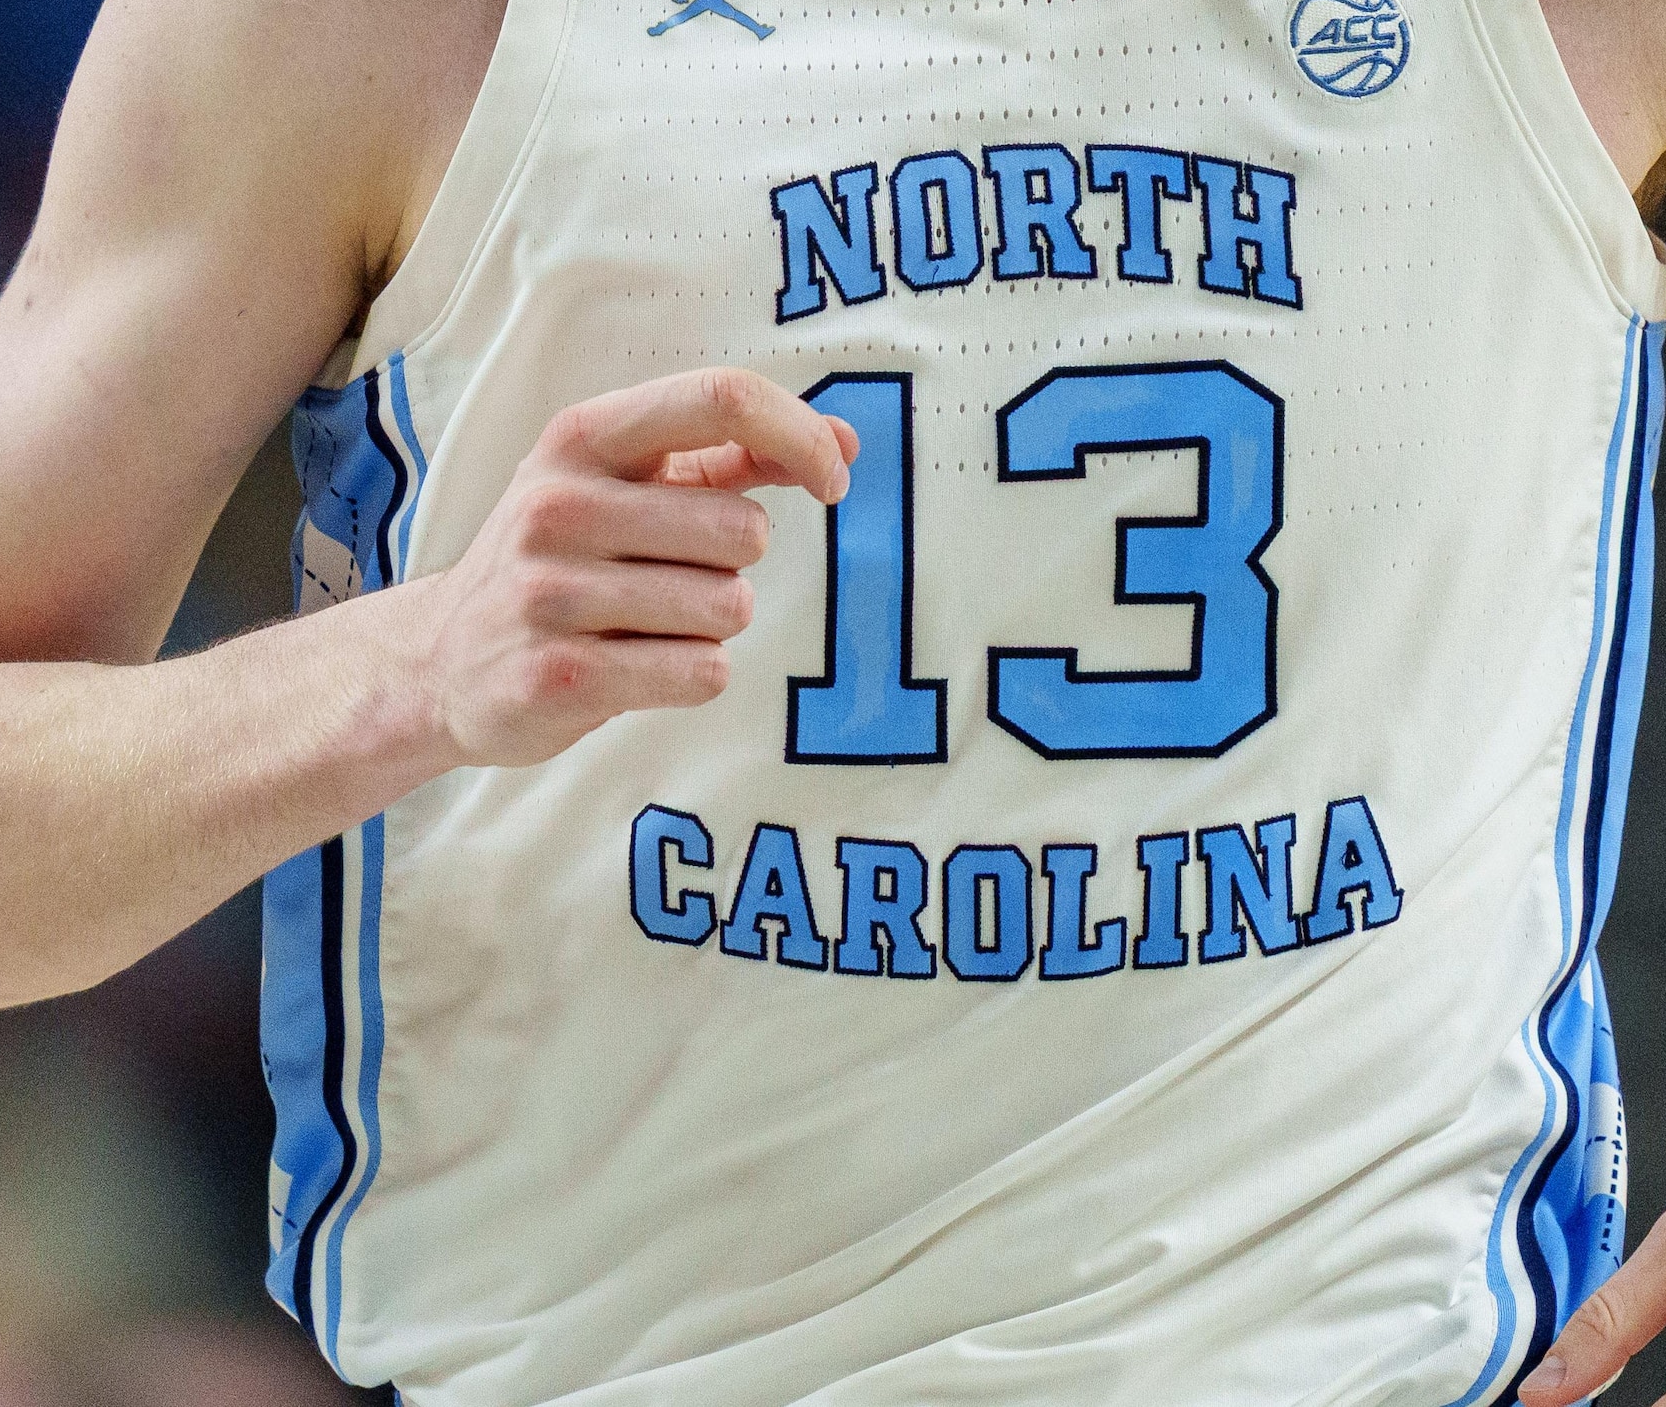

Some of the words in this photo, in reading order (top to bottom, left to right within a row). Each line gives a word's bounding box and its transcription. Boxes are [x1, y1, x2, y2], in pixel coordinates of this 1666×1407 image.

[1306, 14, 1399, 45] ACC
[771, 144, 1303, 324] NORTH
[785, 361, 1285, 765] 13
[630, 797, 1404, 982] CAROLINA
